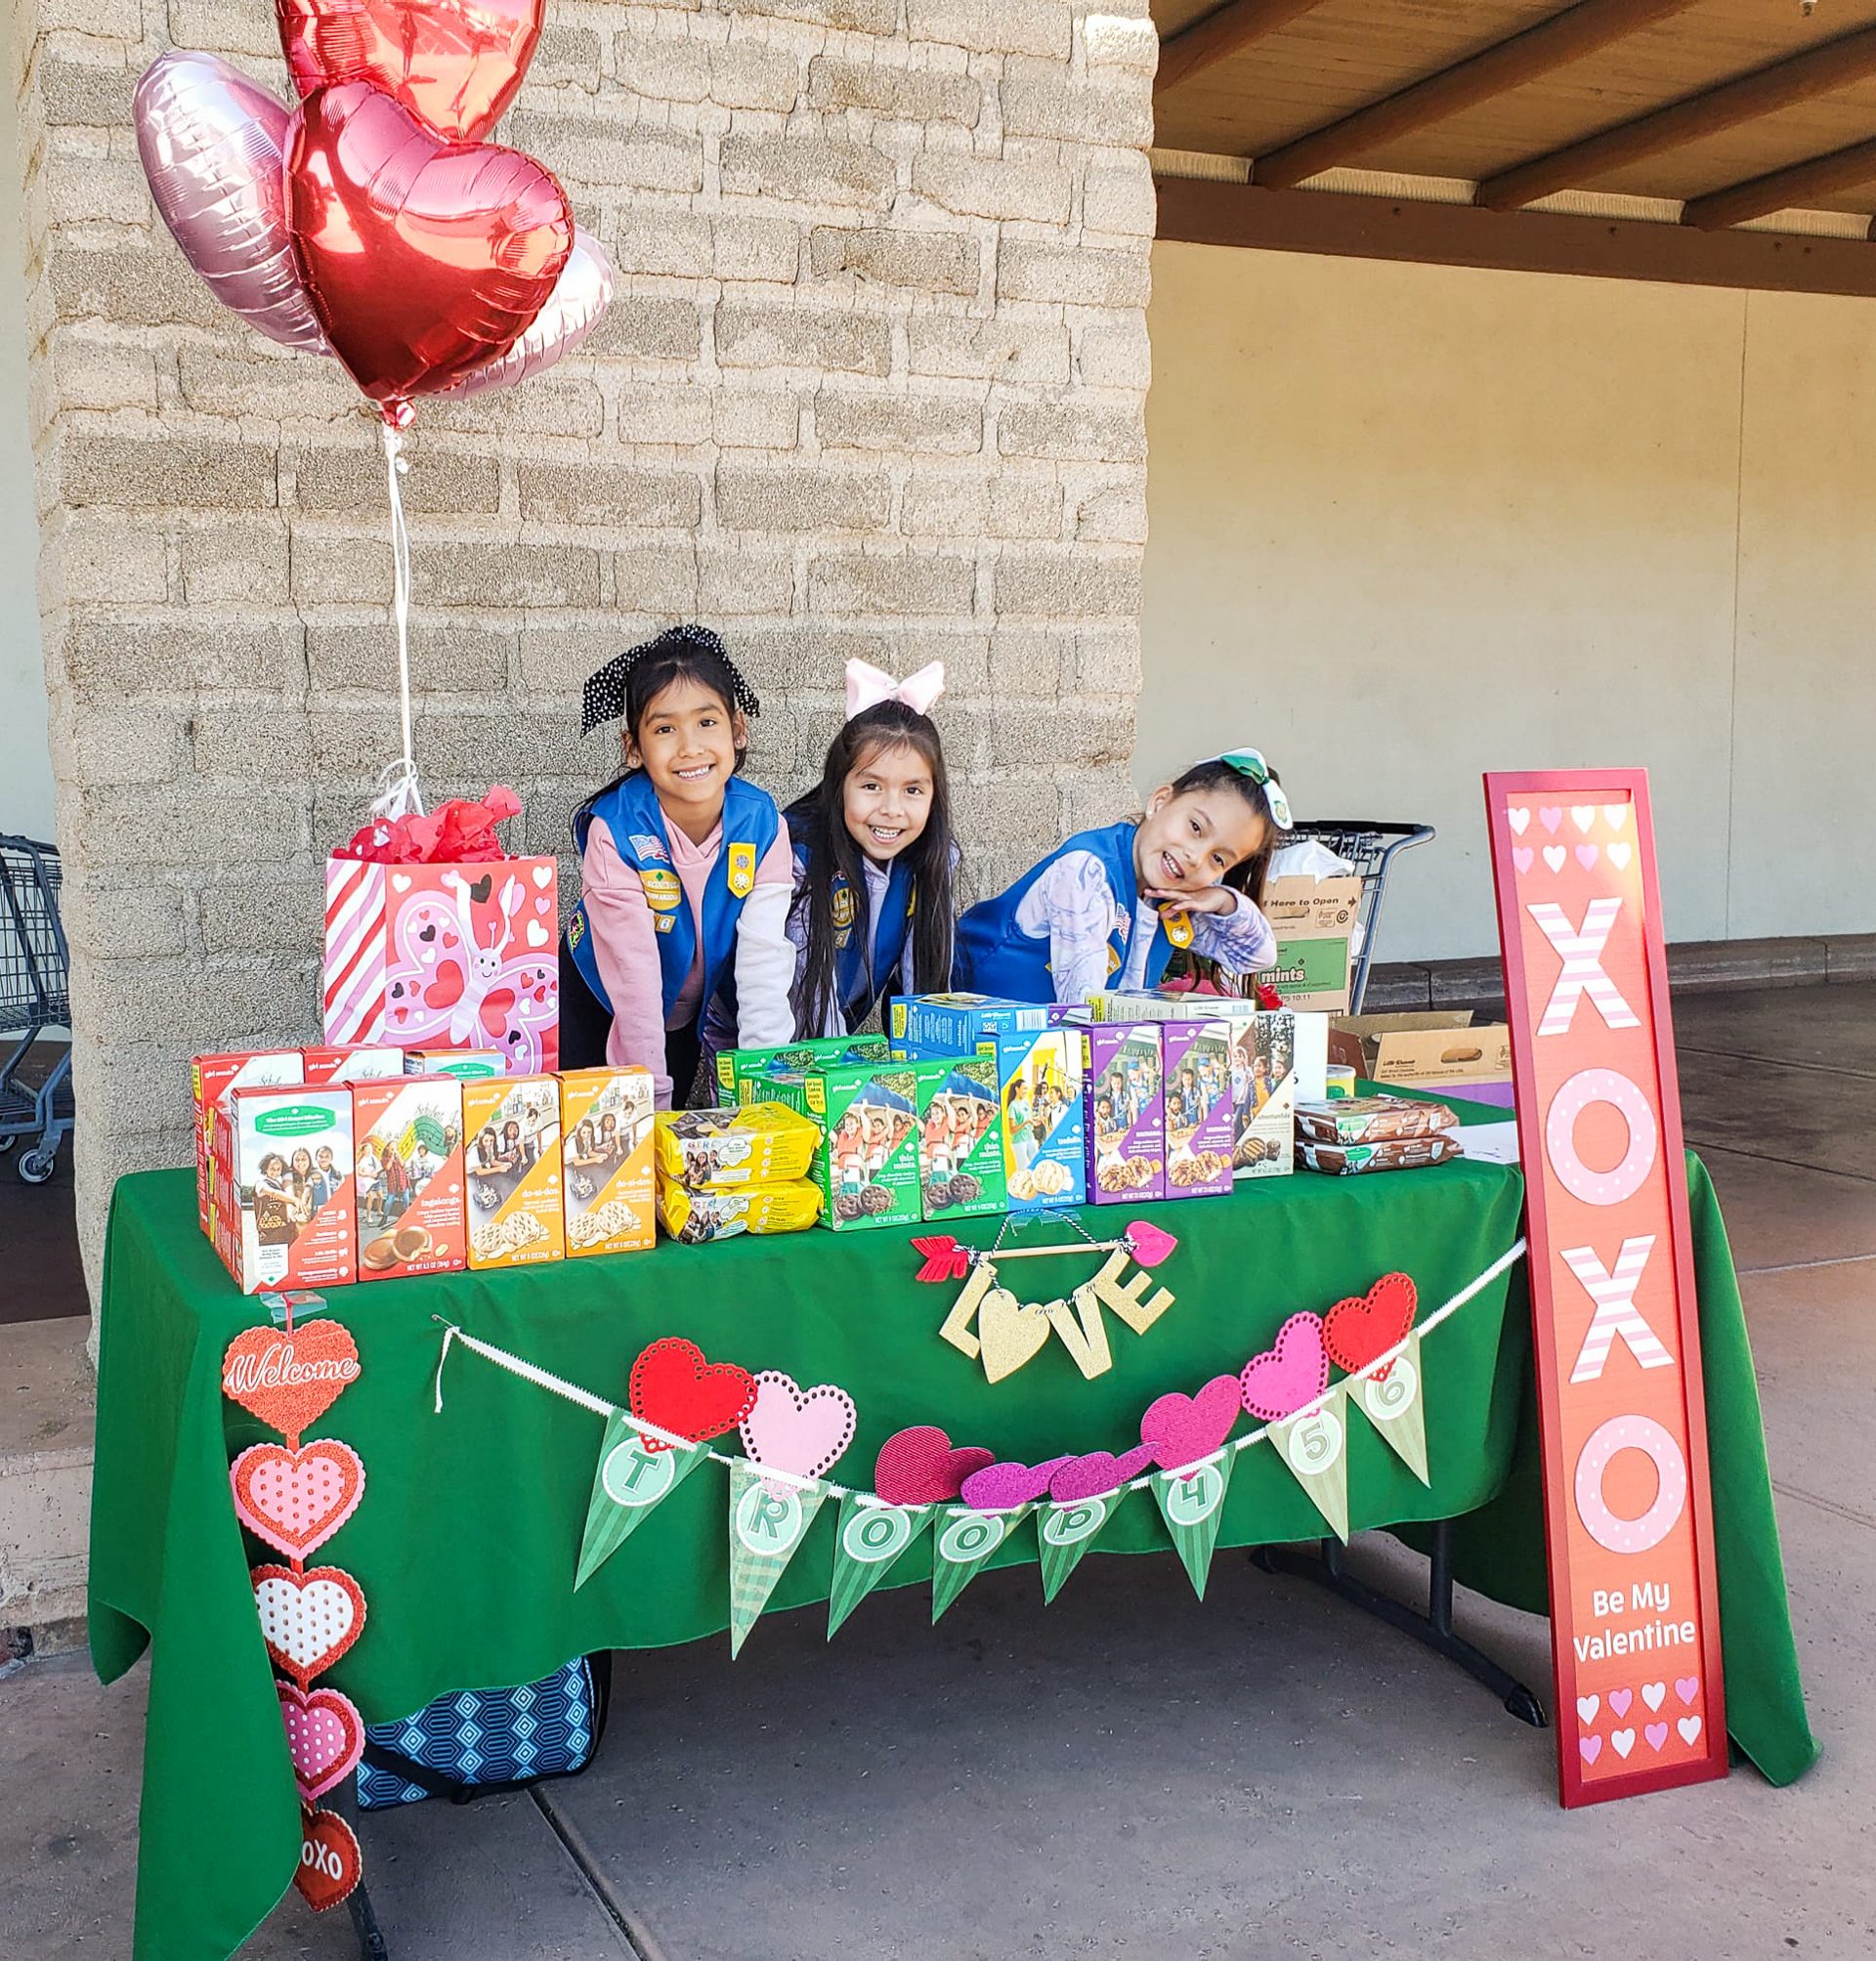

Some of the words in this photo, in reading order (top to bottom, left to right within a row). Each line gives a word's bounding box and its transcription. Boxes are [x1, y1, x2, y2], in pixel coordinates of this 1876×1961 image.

[1260, 966, 1304, 983] mints
[1526, 898, 1686, 1554] XOXO
[226, 1343, 361, 1393] Welcome
[1593, 1589, 1624, 1617] Be
[1632, 1580, 1671, 1612] My
[1573, 1618, 1696, 1664] Valentine
[301, 1838, 343, 1881] OXO
